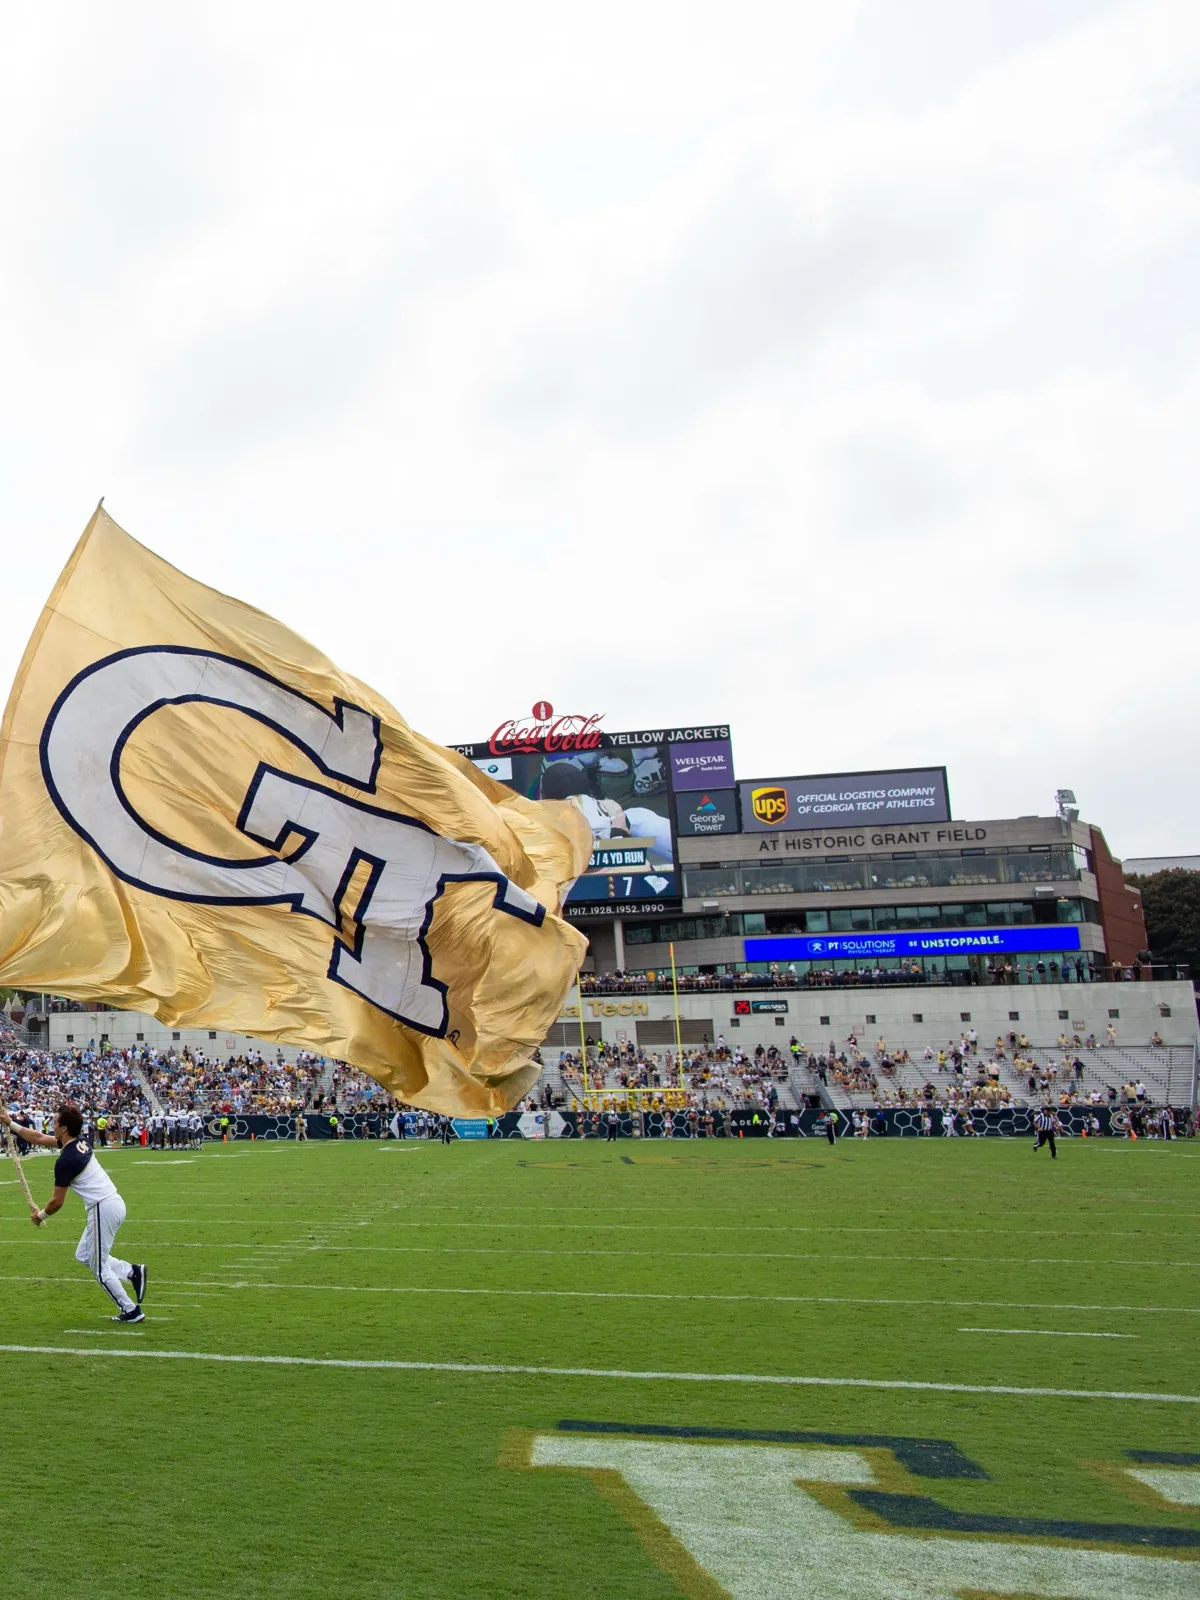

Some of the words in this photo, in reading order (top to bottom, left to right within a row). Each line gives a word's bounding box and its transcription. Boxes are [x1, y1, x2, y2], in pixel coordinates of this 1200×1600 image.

[488, 713, 606, 755] Coca-Cola
[610, 732, 664, 745] YELLOW
[668, 727, 729, 742] JACKETS
[797, 792, 837, 803] OFFICIAL
[839, 789, 886, 800] LOGISTICS
[887, 786, 936, 798] COMPANY
[755, 798, 785, 819] ups
[798, 804, 812, 814] OF
[813, 802, 854, 813] GEORGIA
[886, 798, 935, 809] ATHLETICS
[689, 812, 725, 823] Georgia
[694, 823, 722, 832] Power
[759, 840, 779, 852] AT
[785, 834, 865, 850] HISTORIC
[871, 831, 931, 846] GRANT
[937, 828, 987, 841] FIELD
[602, 852, 609, 865] 4
[610, 852, 623, 864] YD
[625, 851, 644, 863] RUN
[623, 877, 632, 896] 7
[642, 904, 664, 912] 1990
[828, 942, 838, 951] PT
[842, 939, 896, 950] SOLUTIONS
[588, 1000, 648, 1017] Tech
[736, 1002, 749, 1013] 25
